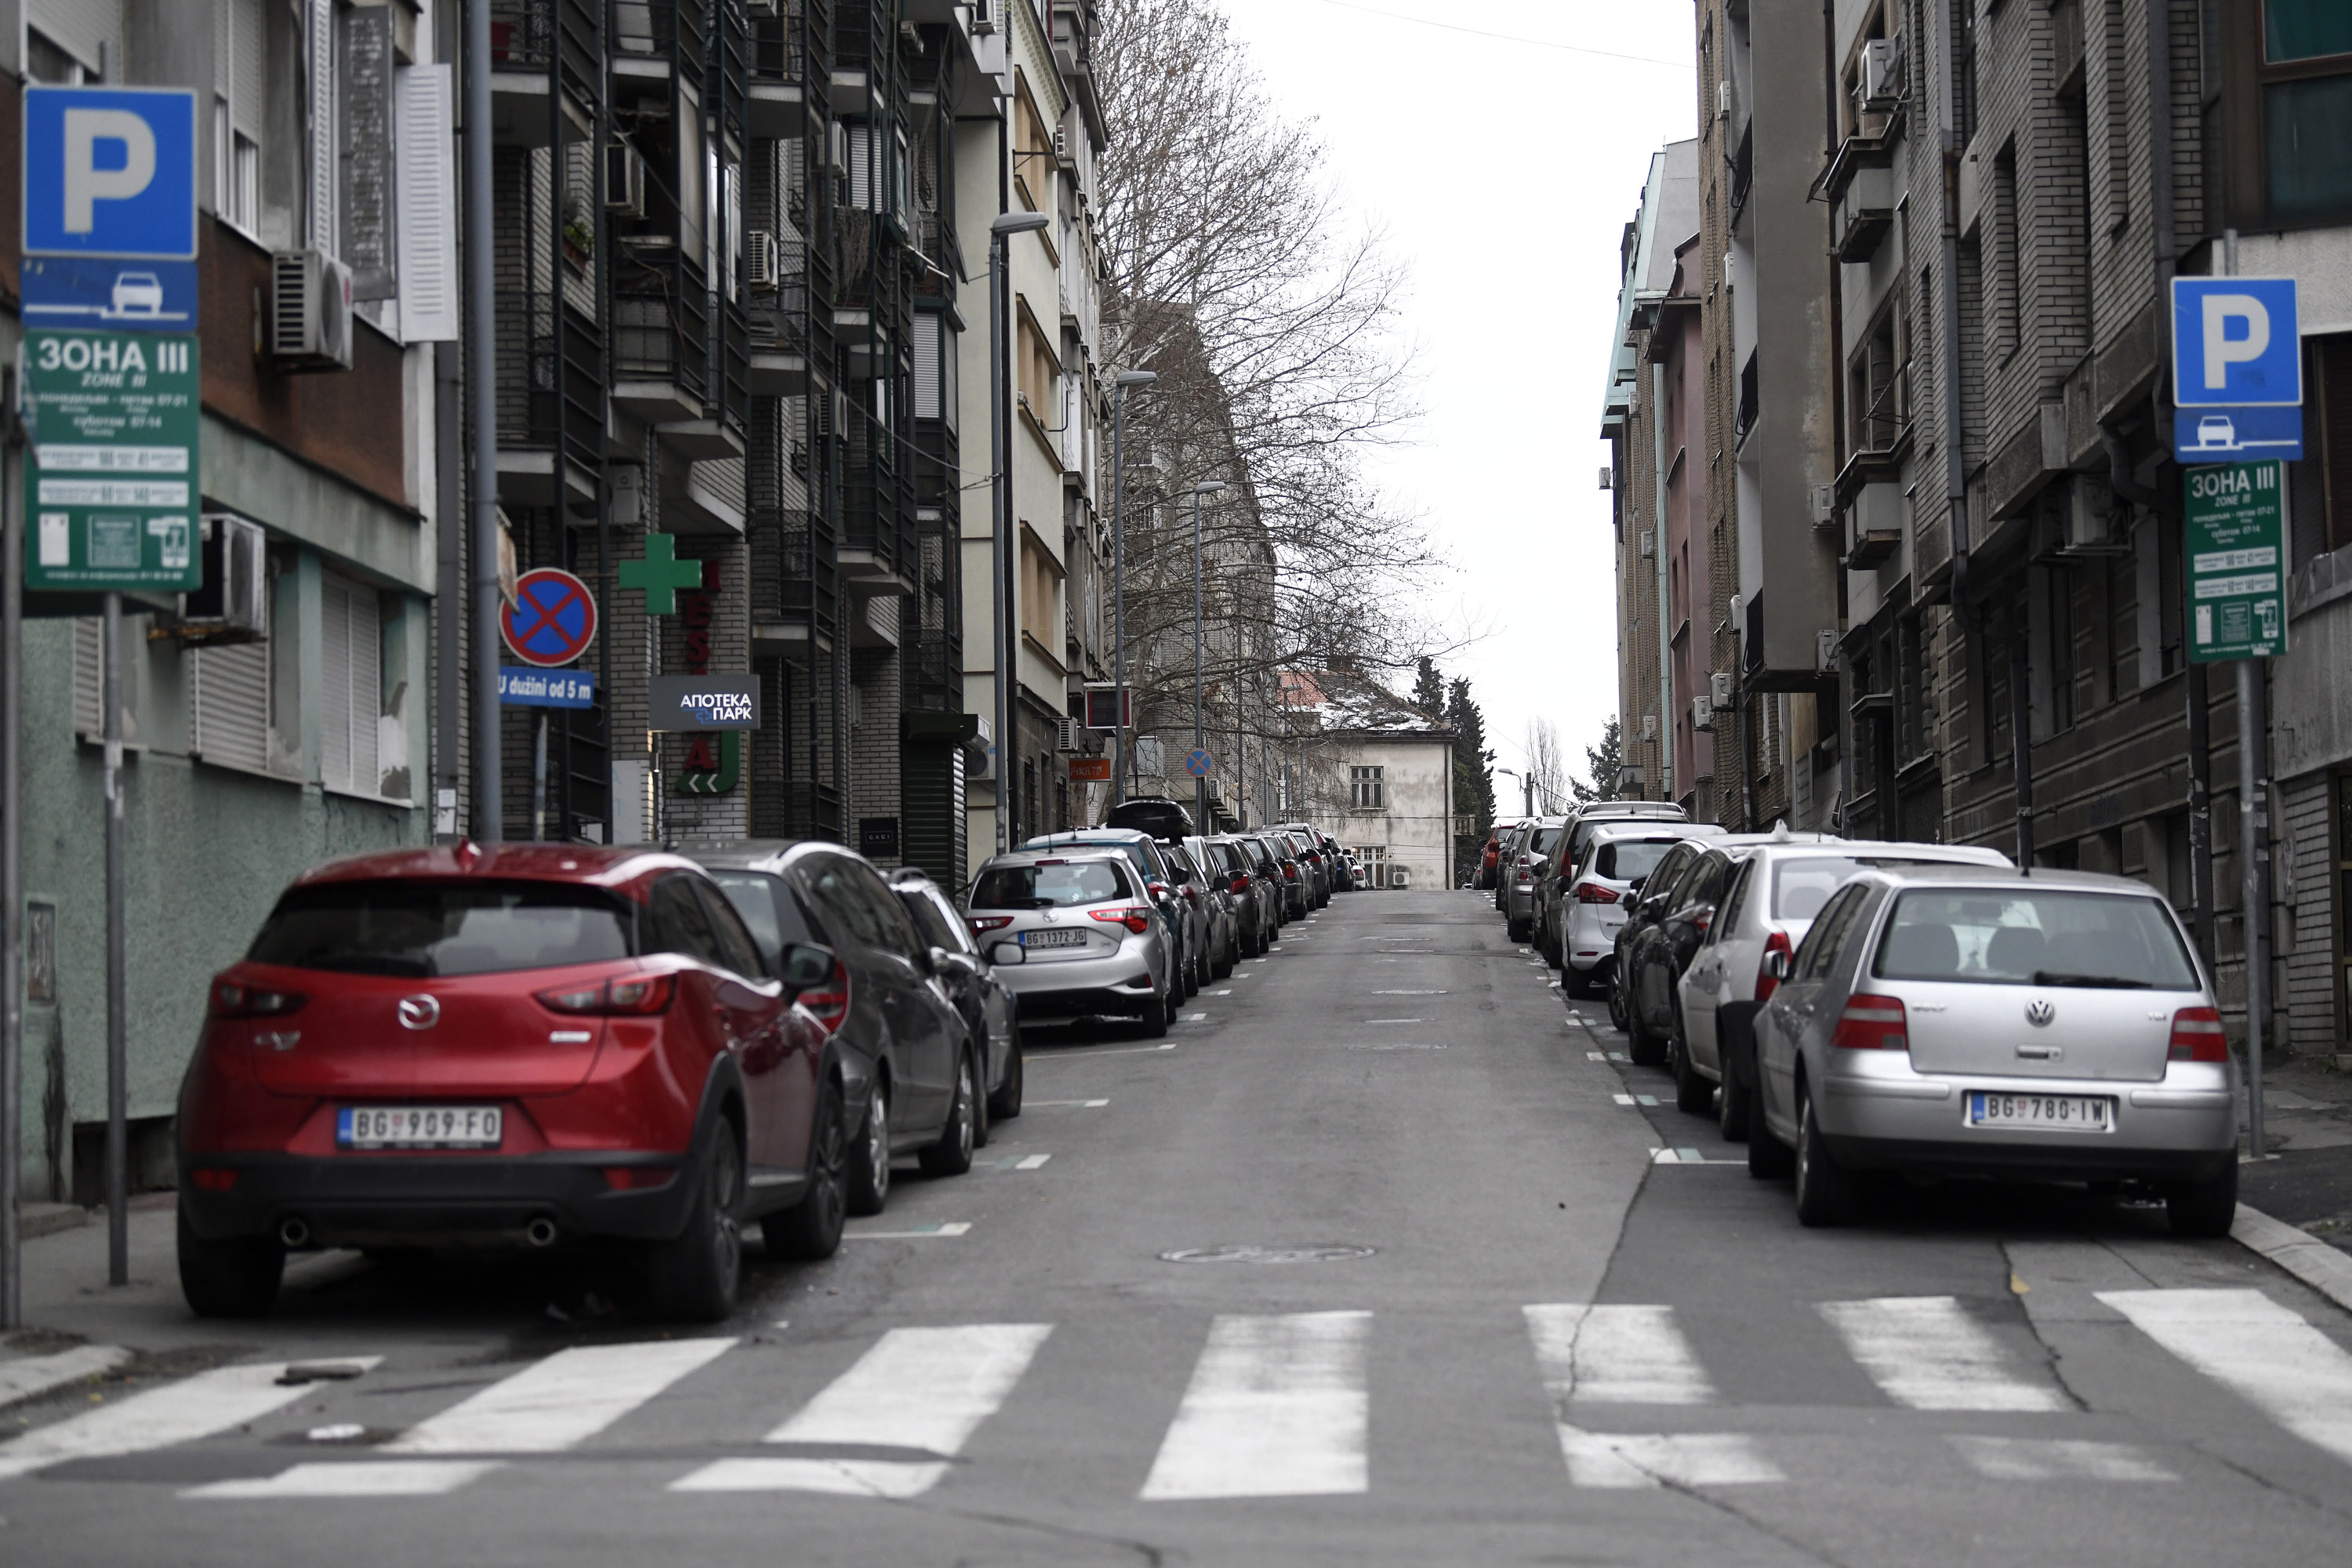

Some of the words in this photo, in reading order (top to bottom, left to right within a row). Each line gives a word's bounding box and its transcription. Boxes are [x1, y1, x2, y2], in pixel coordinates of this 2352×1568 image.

[63, 107, 157, 234] P
[2201, 294, 2270, 389] P
[38, 338, 147, 372] ЗОНА
[158, 342, 188, 373] III
[81, 372, 125, 388] ZONE
[131, 374, 147, 388] III
[2191, 469, 2251, 498] ЗОНА
[2256, 466, 2274, 490] III
[2215, 494, 2239, 507] ZONE
[498, 675, 507, 694] U
[509, 675, 547, 696] dužini
[549, 679, 565, 698] od
[568, 680, 576, 699] 5
[578, 685, 591, 700] m
[681, 693, 752, 707] АПОТЕКА
[713, 707, 753, 720] ПАРК
[1026, 933, 1039, 944] BG
[1988, 1098, 2013, 1117] BG
[357, 1112, 388, 1137] BG
